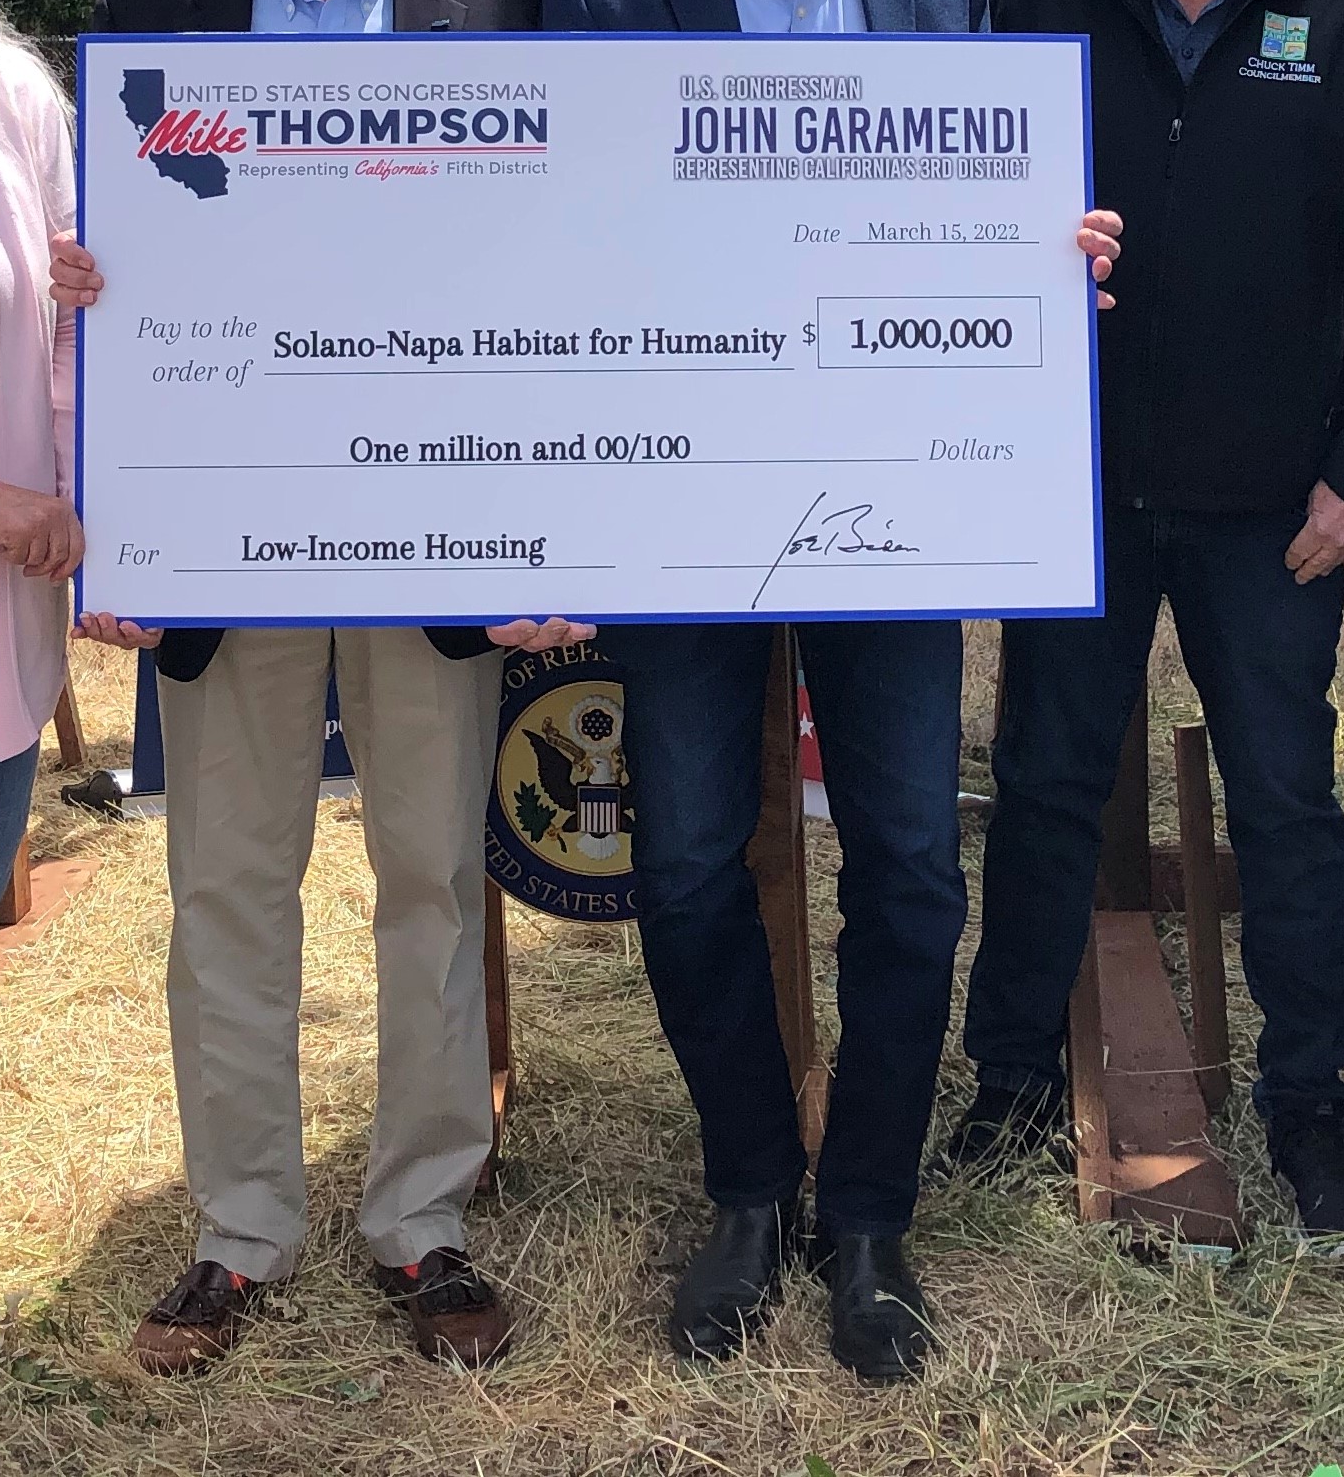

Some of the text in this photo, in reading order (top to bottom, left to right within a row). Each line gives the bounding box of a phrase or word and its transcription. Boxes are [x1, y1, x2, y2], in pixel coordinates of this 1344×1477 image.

[1238, 66, 1322, 83] COUNCILMEMBER
[1247, 56, 1316, 73] CHUCK TIMM
[168, 83, 547, 103] UNITED STATES CONGRESSMAN
[680, 75, 862, 101] U.S. CONGRESSMAN
[137, 108, 548, 160] Mike THOMPSON
[673, 106, 1029, 155] JOHN GARAMENDI
[238, 159, 548, 182] Representing California's Fifth District
[673, 156, 1031, 180] REPRESENTING CALIFORNIA'S 3RD DISTRICT
[792, 222, 1020, 244] Date March 15, 2022
[136, 315, 258, 346] Pay to the
[273, 317, 1013, 365] Solano-Napa Habitat for Humanity $ 1,000,000
[152, 358, 255, 389] order of
[349, 433, 1016, 463] One million and 00/100 Dollars
[116, 532, 548, 567] For Low-Income Housing
[507, 658, 537, 690] OF
[522, 874, 619, 915] STATES
